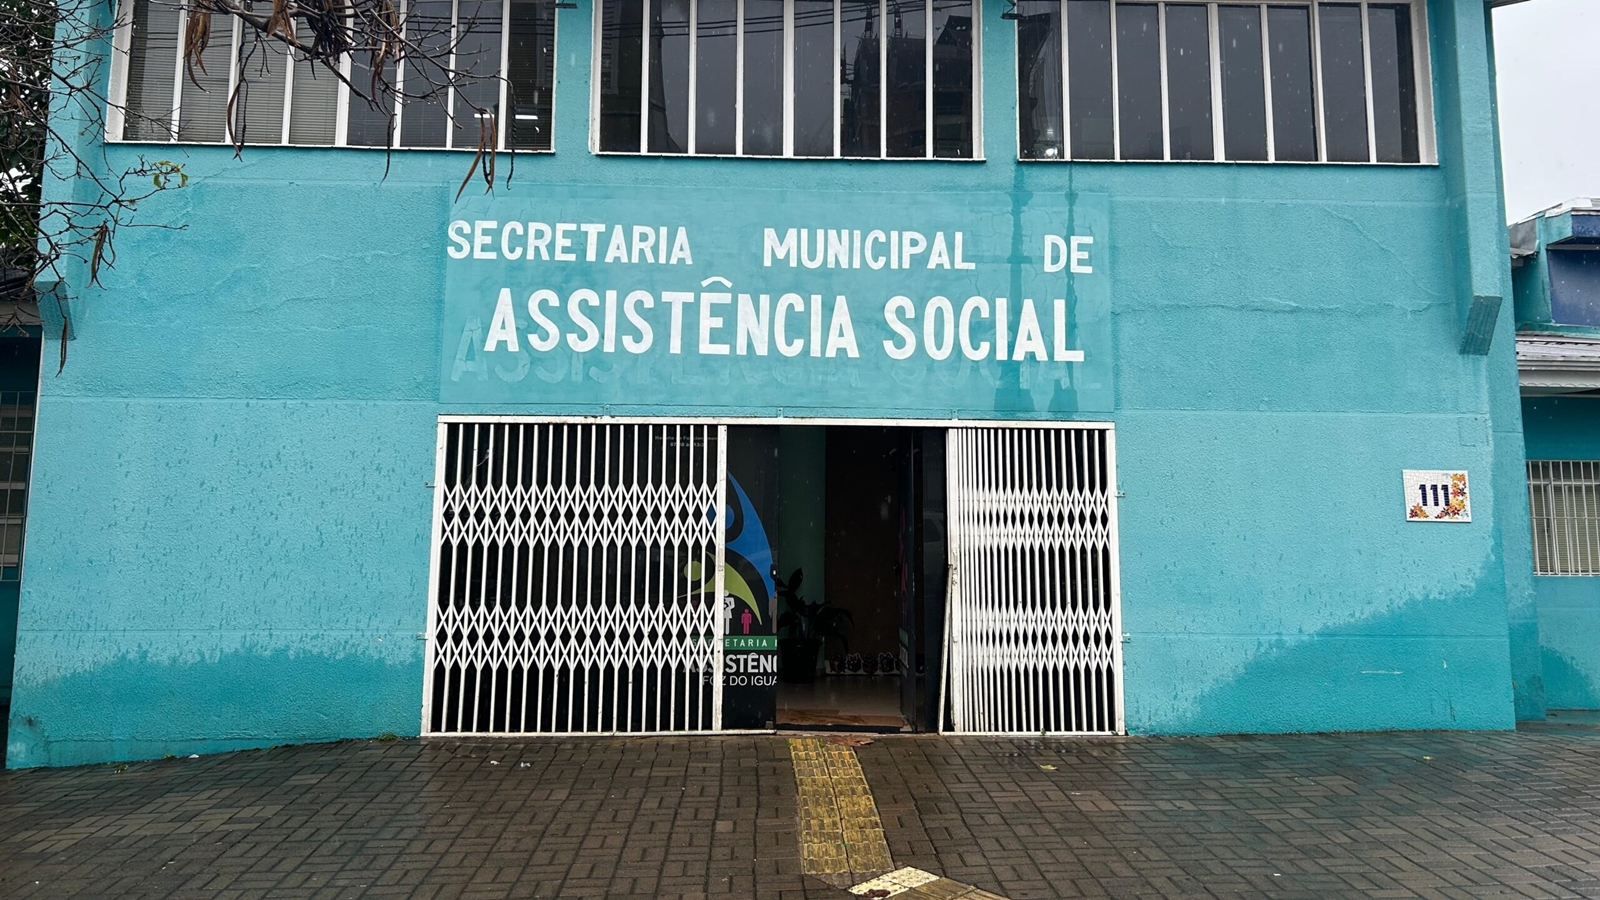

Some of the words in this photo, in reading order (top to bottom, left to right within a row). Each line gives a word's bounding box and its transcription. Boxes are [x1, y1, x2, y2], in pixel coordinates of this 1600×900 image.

[447, 220, 693, 265] SECRETARIA
[763, 228, 976, 270] MUNICIPAL
[1043, 234, 1094, 274] DE
[483, 276, 860, 358] ASSISTÊNCIA
[882, 295, 1085, 363] SOCIAL
[1418, 484, 1450, 506] 111
[729, 675, 748, 686] DO
